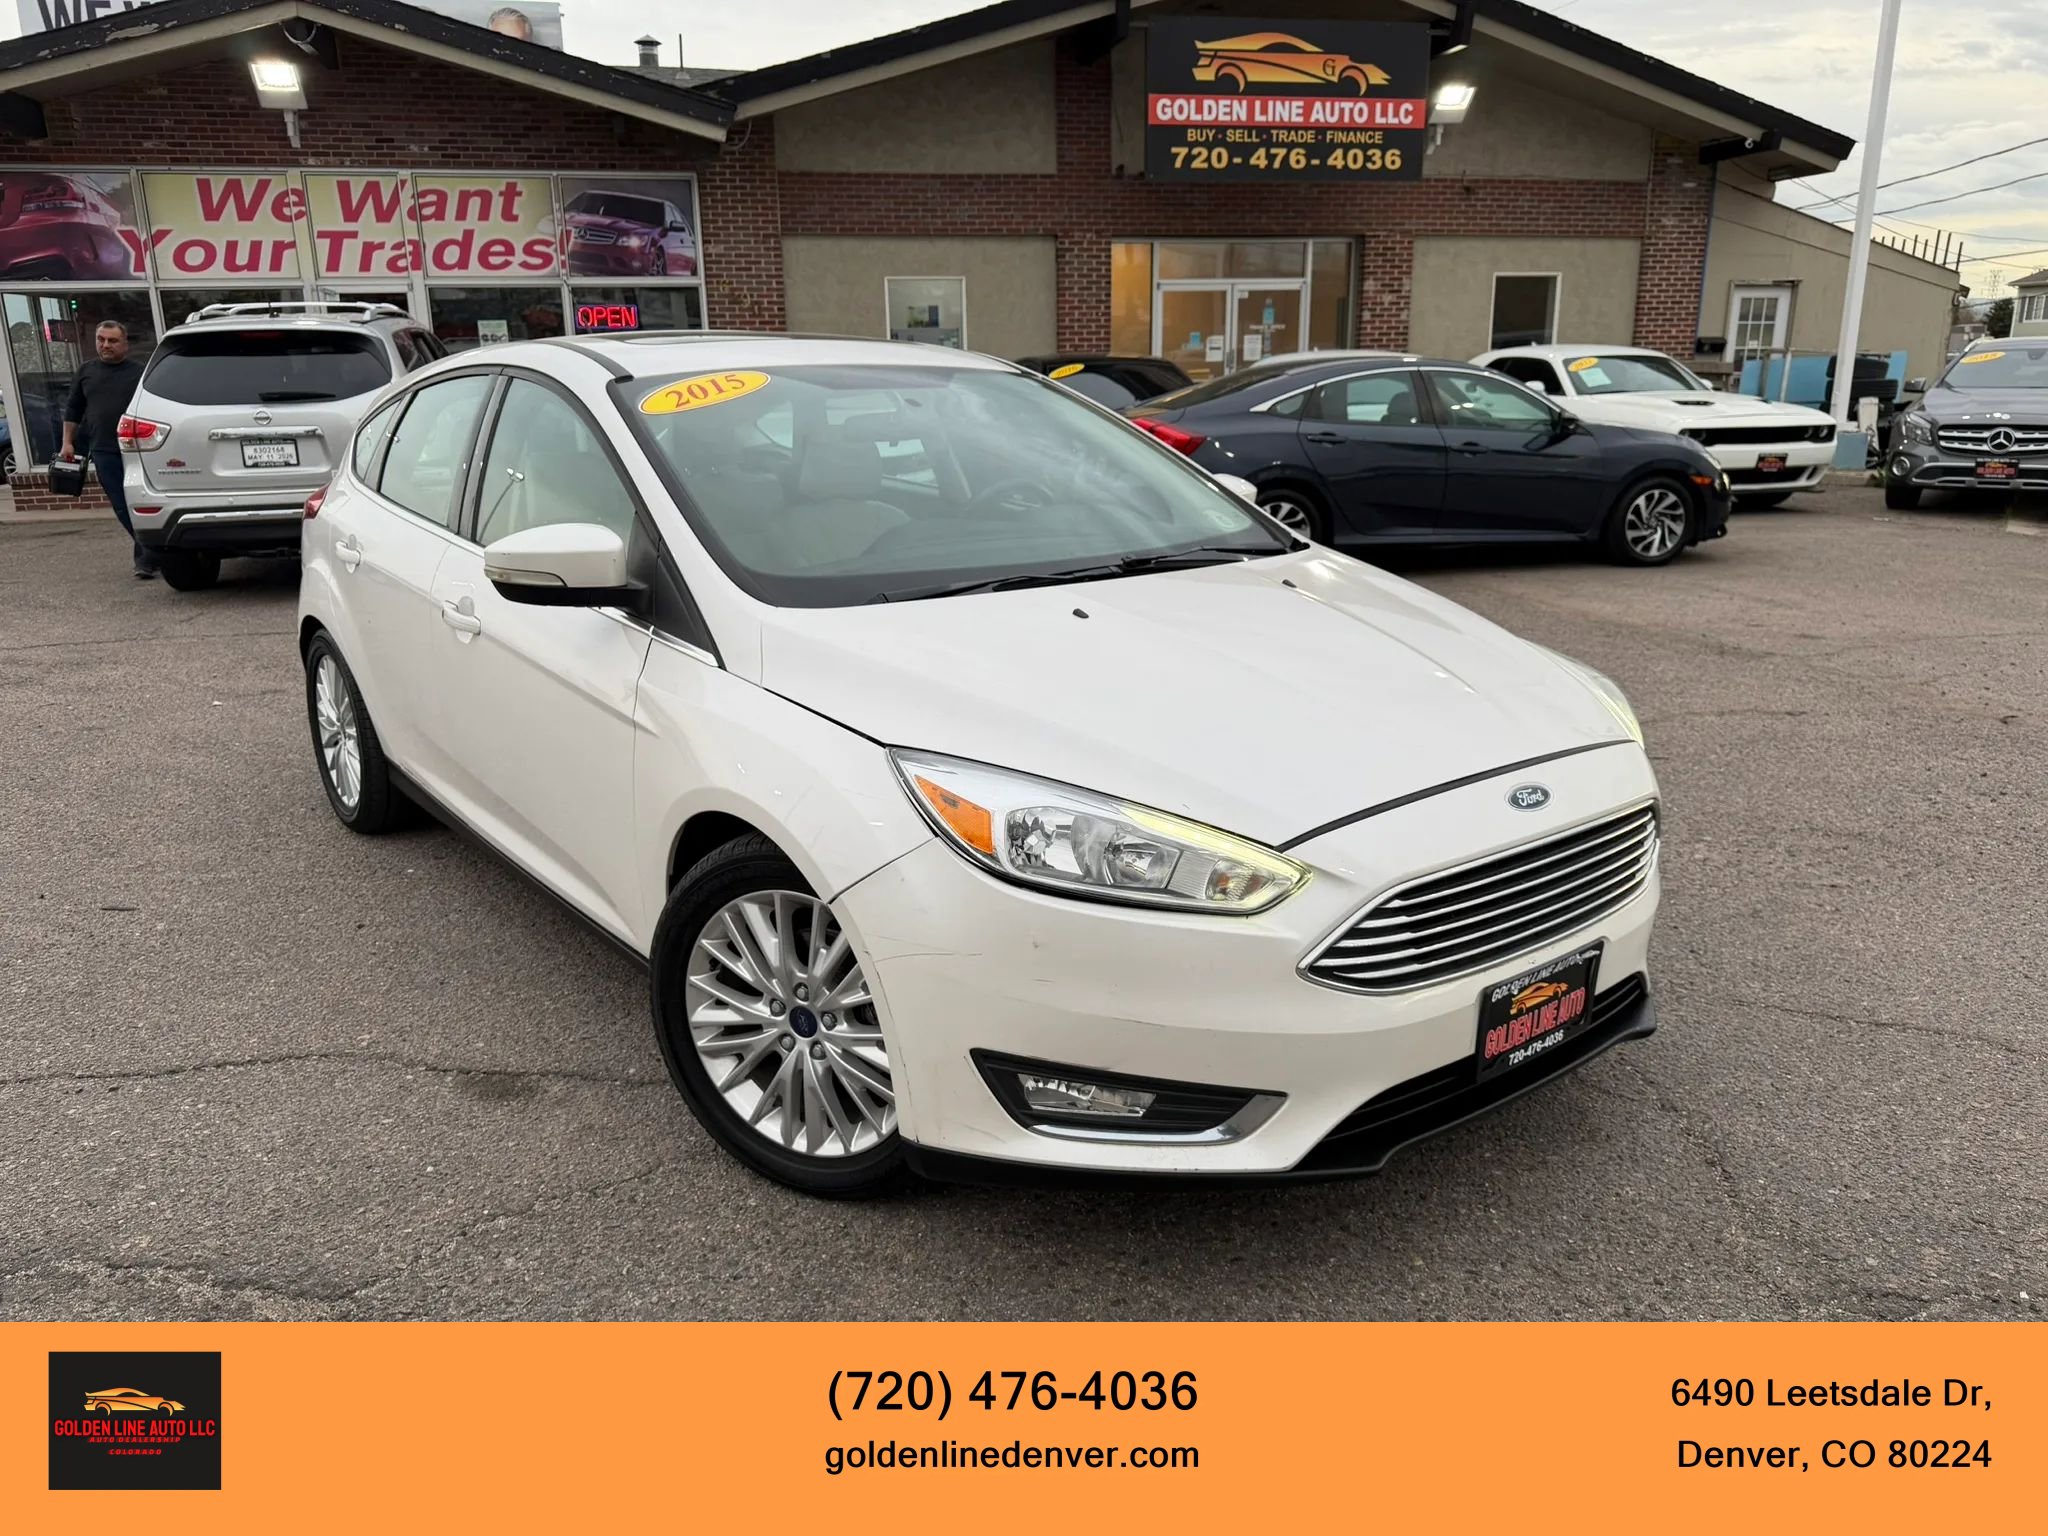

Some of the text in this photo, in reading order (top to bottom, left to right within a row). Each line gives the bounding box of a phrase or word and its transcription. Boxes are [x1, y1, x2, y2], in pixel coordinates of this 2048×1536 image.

[1156, 98, 1414, 124] GOLDEN LINE AUTO LLC
[1187, 129, 1383, 144] BUY SELL TRADE FINANCE
[196, 178, 523, 223] We Want
[118, 229, 572, 273] Your Trades!
[577, 306, 636, 327] OPEN
[665, 374, 745, 409] 2015
[1516, 788, 1545, 807] Ford
[1530, 964, 1556, 985] LINE
[1485, 986, 1585, 1059] GOLDEN LINE AUTO
[1509, 1029, 1564, 1066] 720-476-4036
